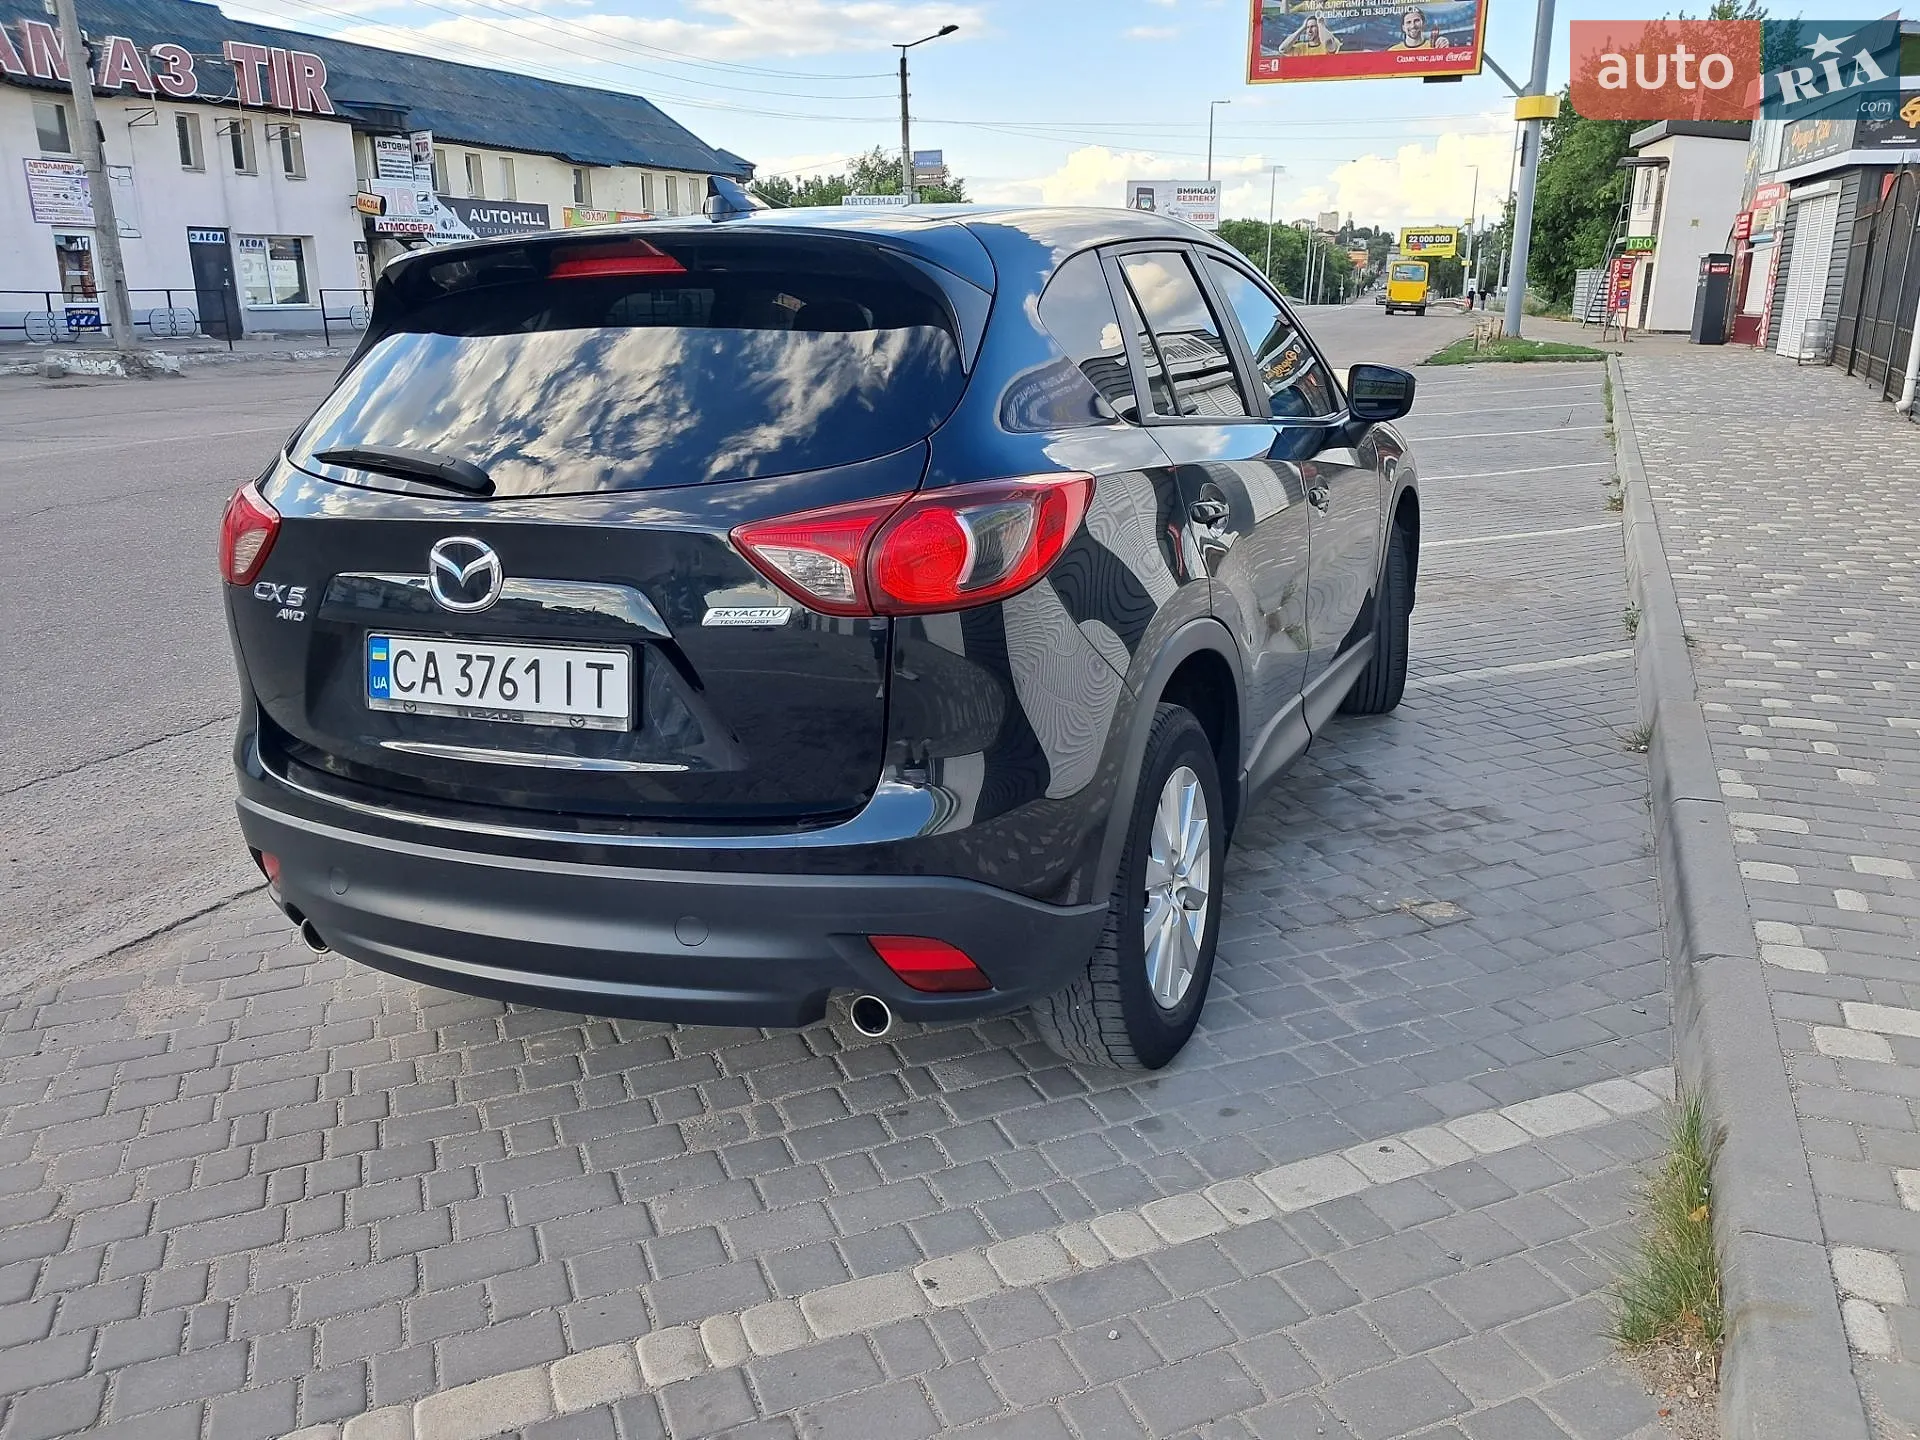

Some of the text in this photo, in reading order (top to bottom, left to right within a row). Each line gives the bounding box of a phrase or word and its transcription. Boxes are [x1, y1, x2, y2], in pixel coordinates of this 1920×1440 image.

[1361, 8, 1372, 16] та
[1429, 54, 1443, 62] для
[223, 40, 335, 115] TIR
[414, 141, 429, 152] TIR
[358, 197, 379, 209] МАСЛА
[469, 208, 545, 226] AUTOHILL
[580, 211, 608, 221] ЧОХЛИ
[378, 222, 435, 233] АТМОСФЕРА
[426, 232, 475, 240] ПНЕВМАТИКА
[1629, 238, 1652, 249] ГБО
[276, 608, 305, 621] AWD
[712, 609, 783, 617] SKYACTIV
[373, 675, 388, 690] UA
[455, 653, 540, 704] 3761
[565, 661, 615, 709] IT
